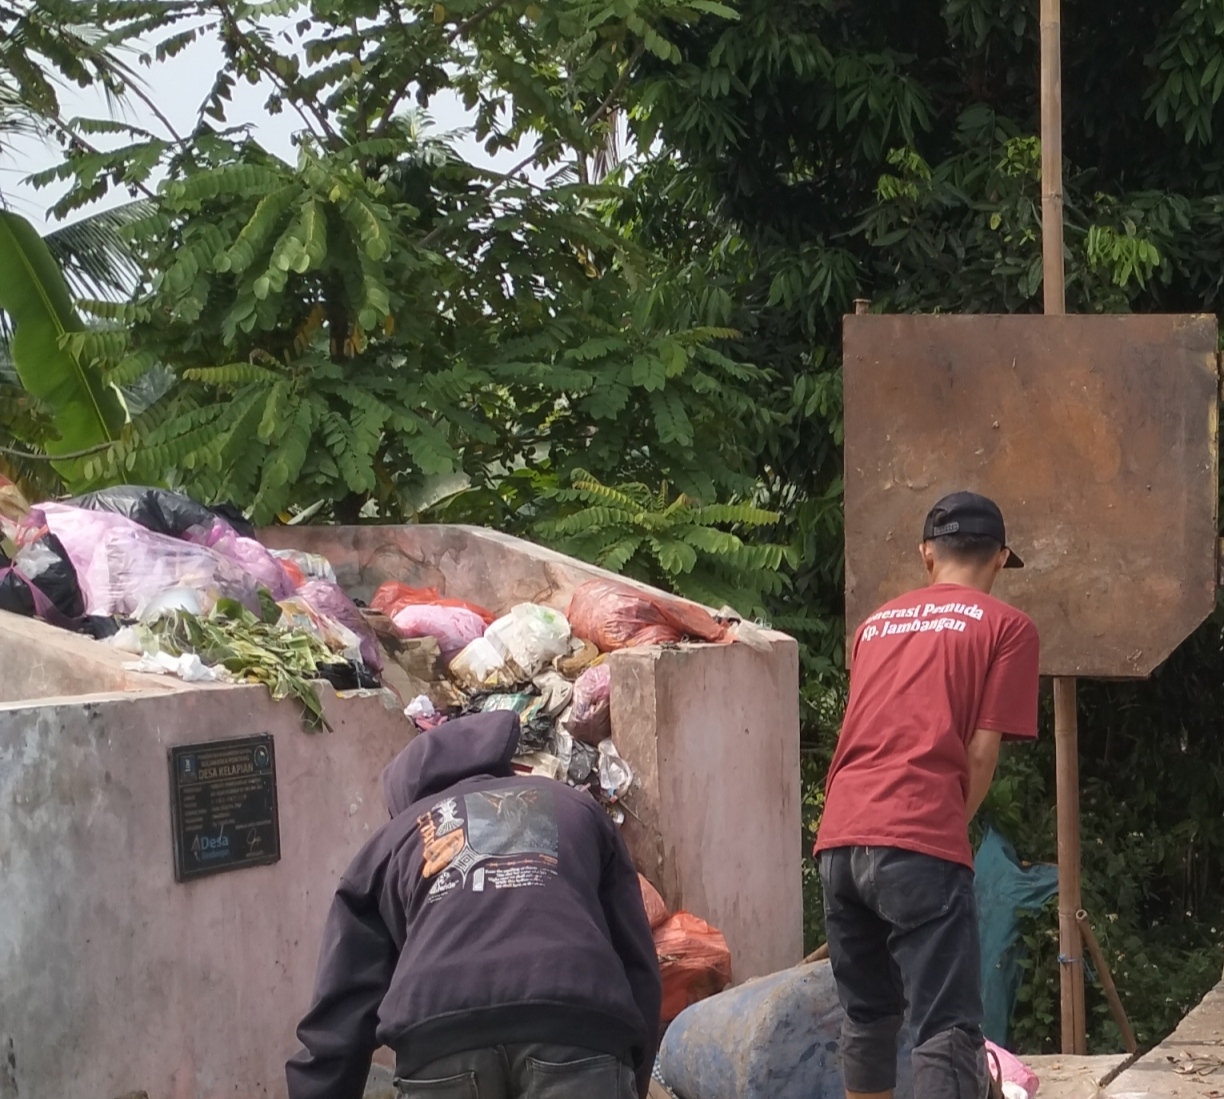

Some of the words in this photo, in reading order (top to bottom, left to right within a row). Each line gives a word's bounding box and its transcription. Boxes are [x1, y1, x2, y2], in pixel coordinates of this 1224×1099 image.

[922, 602, 984, 620] Pemuda
[880, 617, 967, 638] Jambangan
[198, 767, 218, 780] DESA
[218, 763, 254, 778] KELAPIAN
[200, 835, 229, 850] Desa
